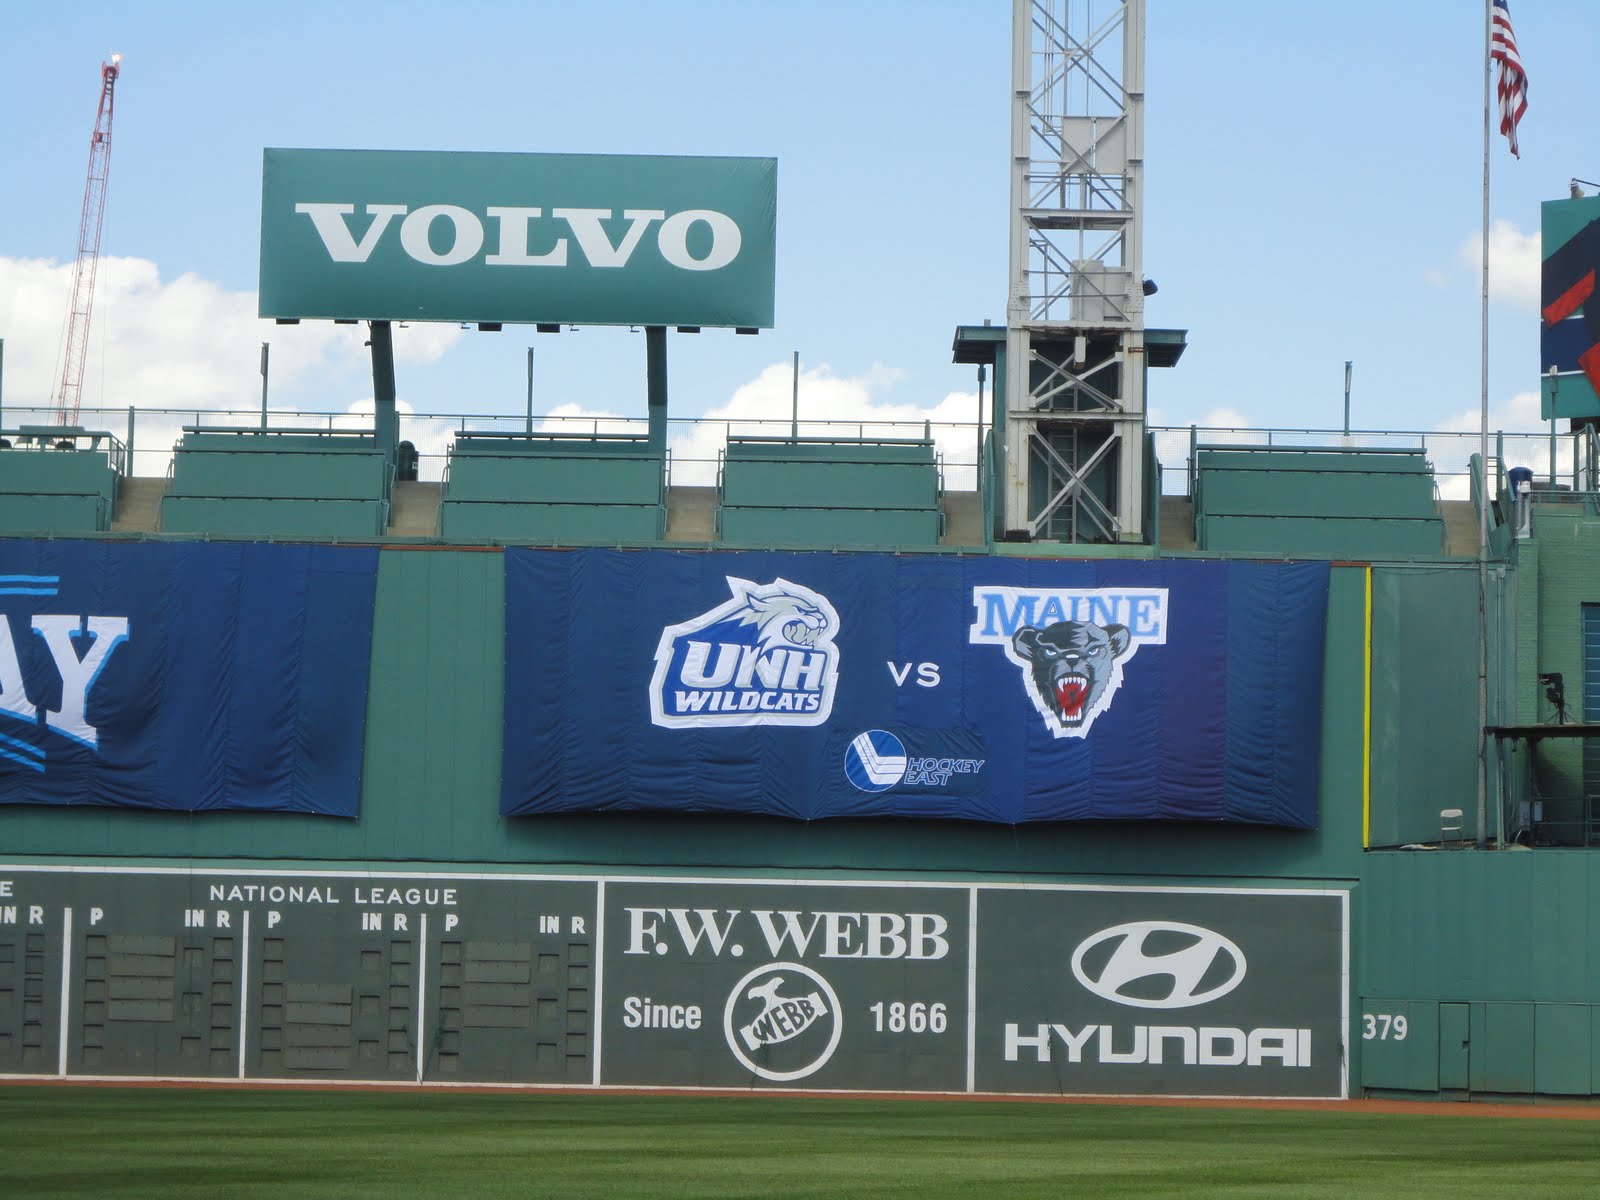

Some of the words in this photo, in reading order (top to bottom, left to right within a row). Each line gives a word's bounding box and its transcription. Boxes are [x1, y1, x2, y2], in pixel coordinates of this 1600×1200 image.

[295, 203, 742, 271] VOLVO
[980, 593, 1161, 637] MAINE
[680, 640, 827, 691] UNH
[675, 690, 821, 712] WILDCATS
[904, 770, 953, 785] EAST
[907, 757, 986, 773] HOCKEY
[210, 885, 340, 904] NATIONAL
[354, 887, 458, 905] LEAGUE
[0, 906, 17, 924] N
[29, 905, 44, 924] R
[90, 907, 104, 925] P
[184, 909, 205, 927] IN
[216, 910, 231, 928] R
[267, 911, 281, 929] P
[362, 912, 382, 931] IN
[393, 913, 408, 931] R
[445, 913, 459, 932] P
[539, 915, 560, 934] IN
[571, 916, 586, 934] R
[623, 907, 744, 957] F.W.
[750, 910, 950, 960] WEBB
[623, 996, 702, 1030] Since
[870, 1001, 947, 1034] 1866
[752, 999, 816, 1041] WEBB
[1362, 1013, 1408, 1041] 379
[1004, 1023, 1312, 1067] HYUNDAI
